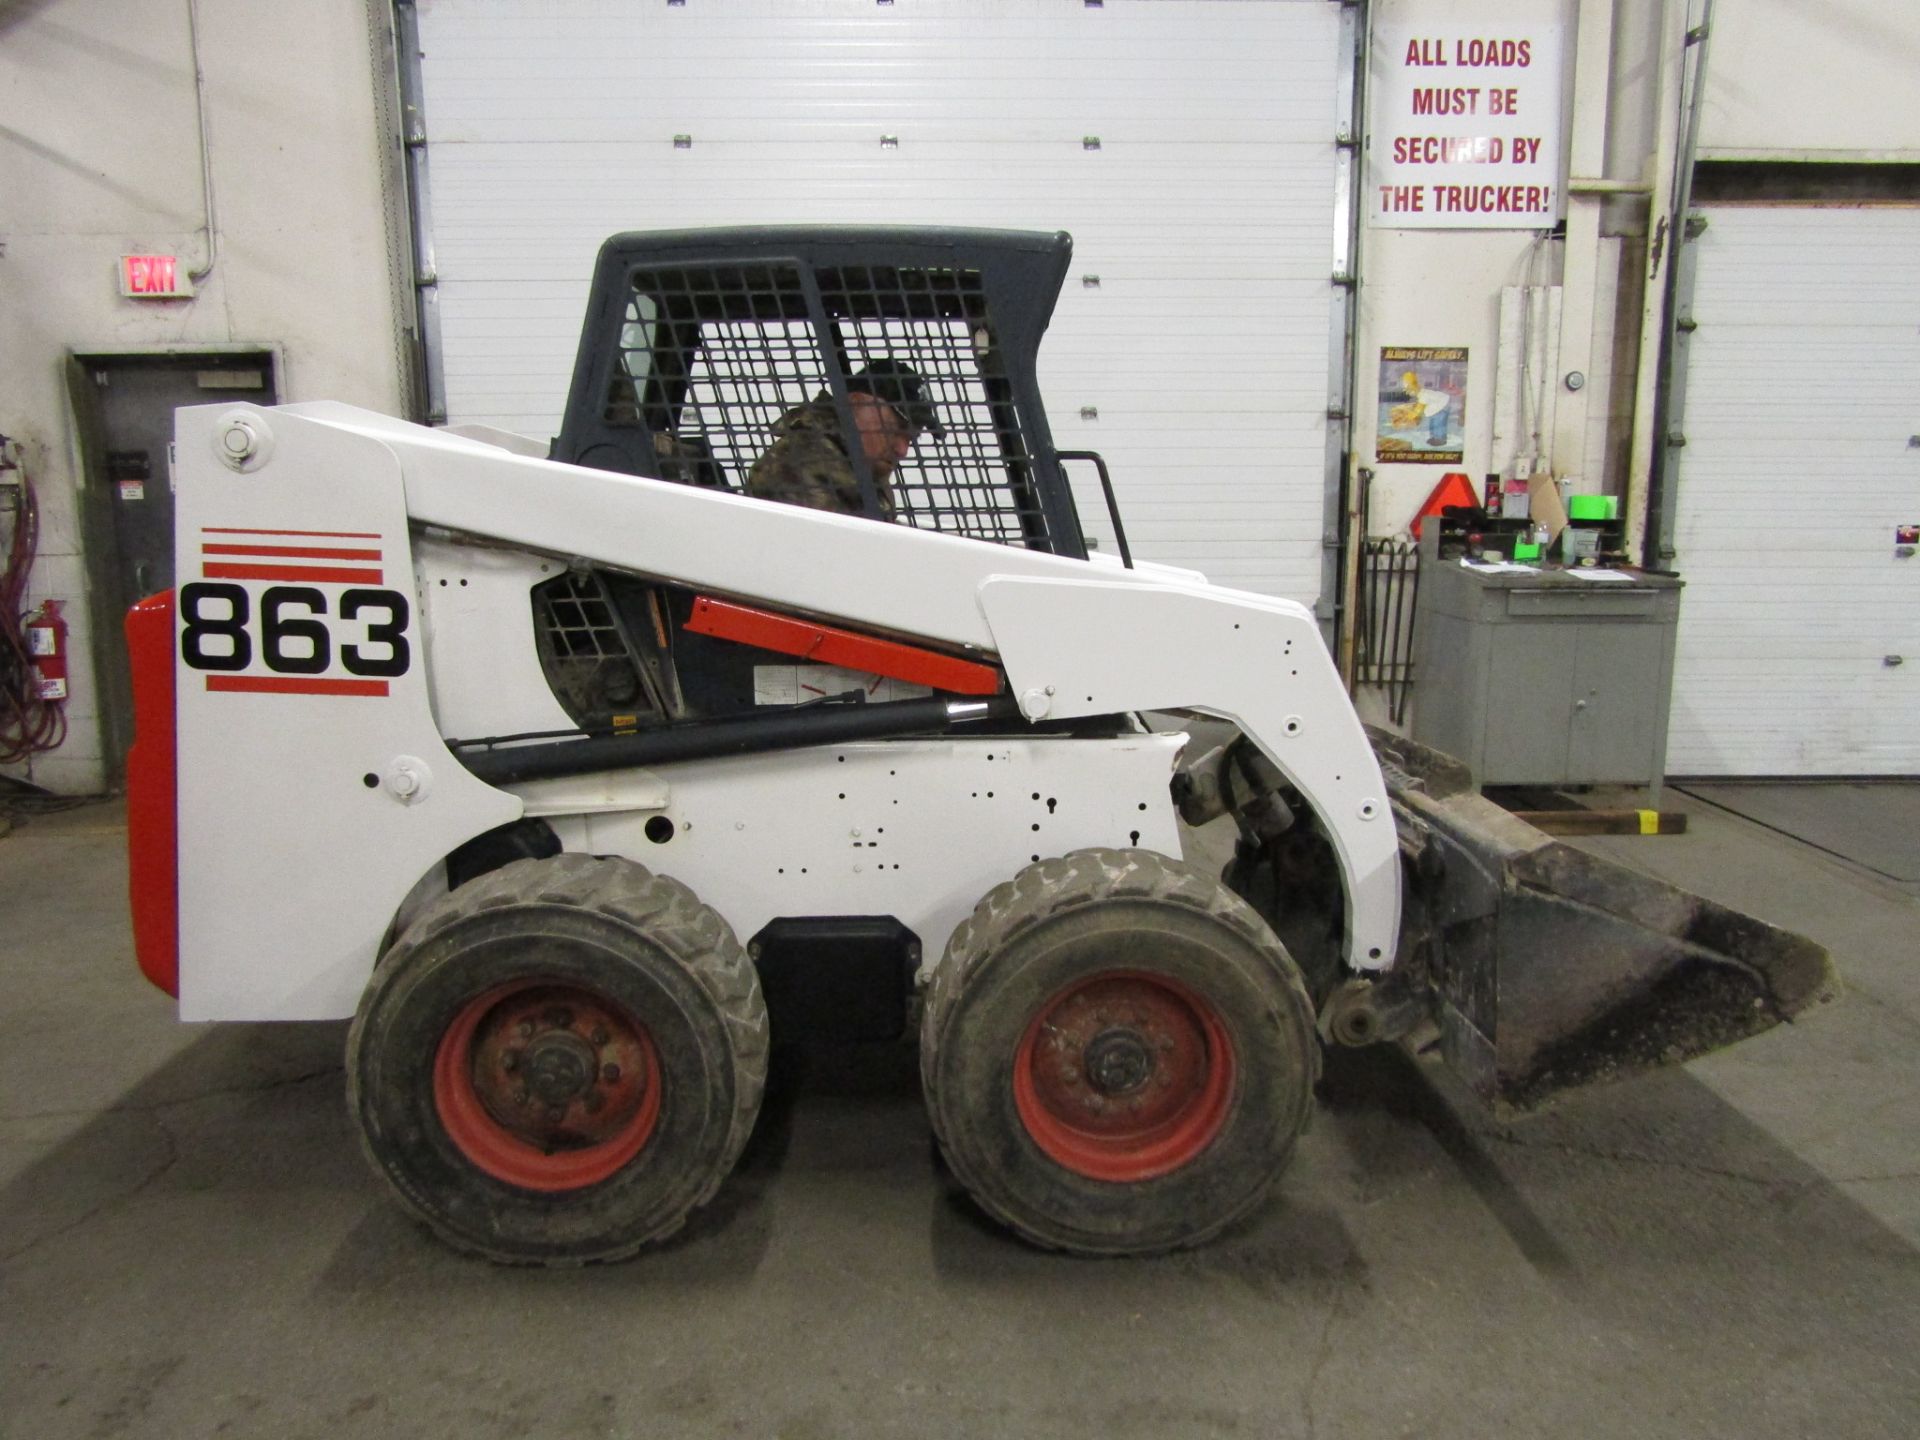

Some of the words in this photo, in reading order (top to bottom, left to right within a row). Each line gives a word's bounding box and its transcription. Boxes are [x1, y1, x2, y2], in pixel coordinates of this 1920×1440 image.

[1405, 39, 1447, 66] ALL
[1456, 39, 1531, 67] LOADS
[1412, 88, 1480, 115] MUST
[1488, 88, 1518, 115] BE
[1512, 137, 1541, 164] BY
[1379, 185, 1424, 212] THE
[1433, 185, 1549, 213] TRUCKER!
[128, 256, 176, 292] EXIT
[180, 582, 410, 677] 863
